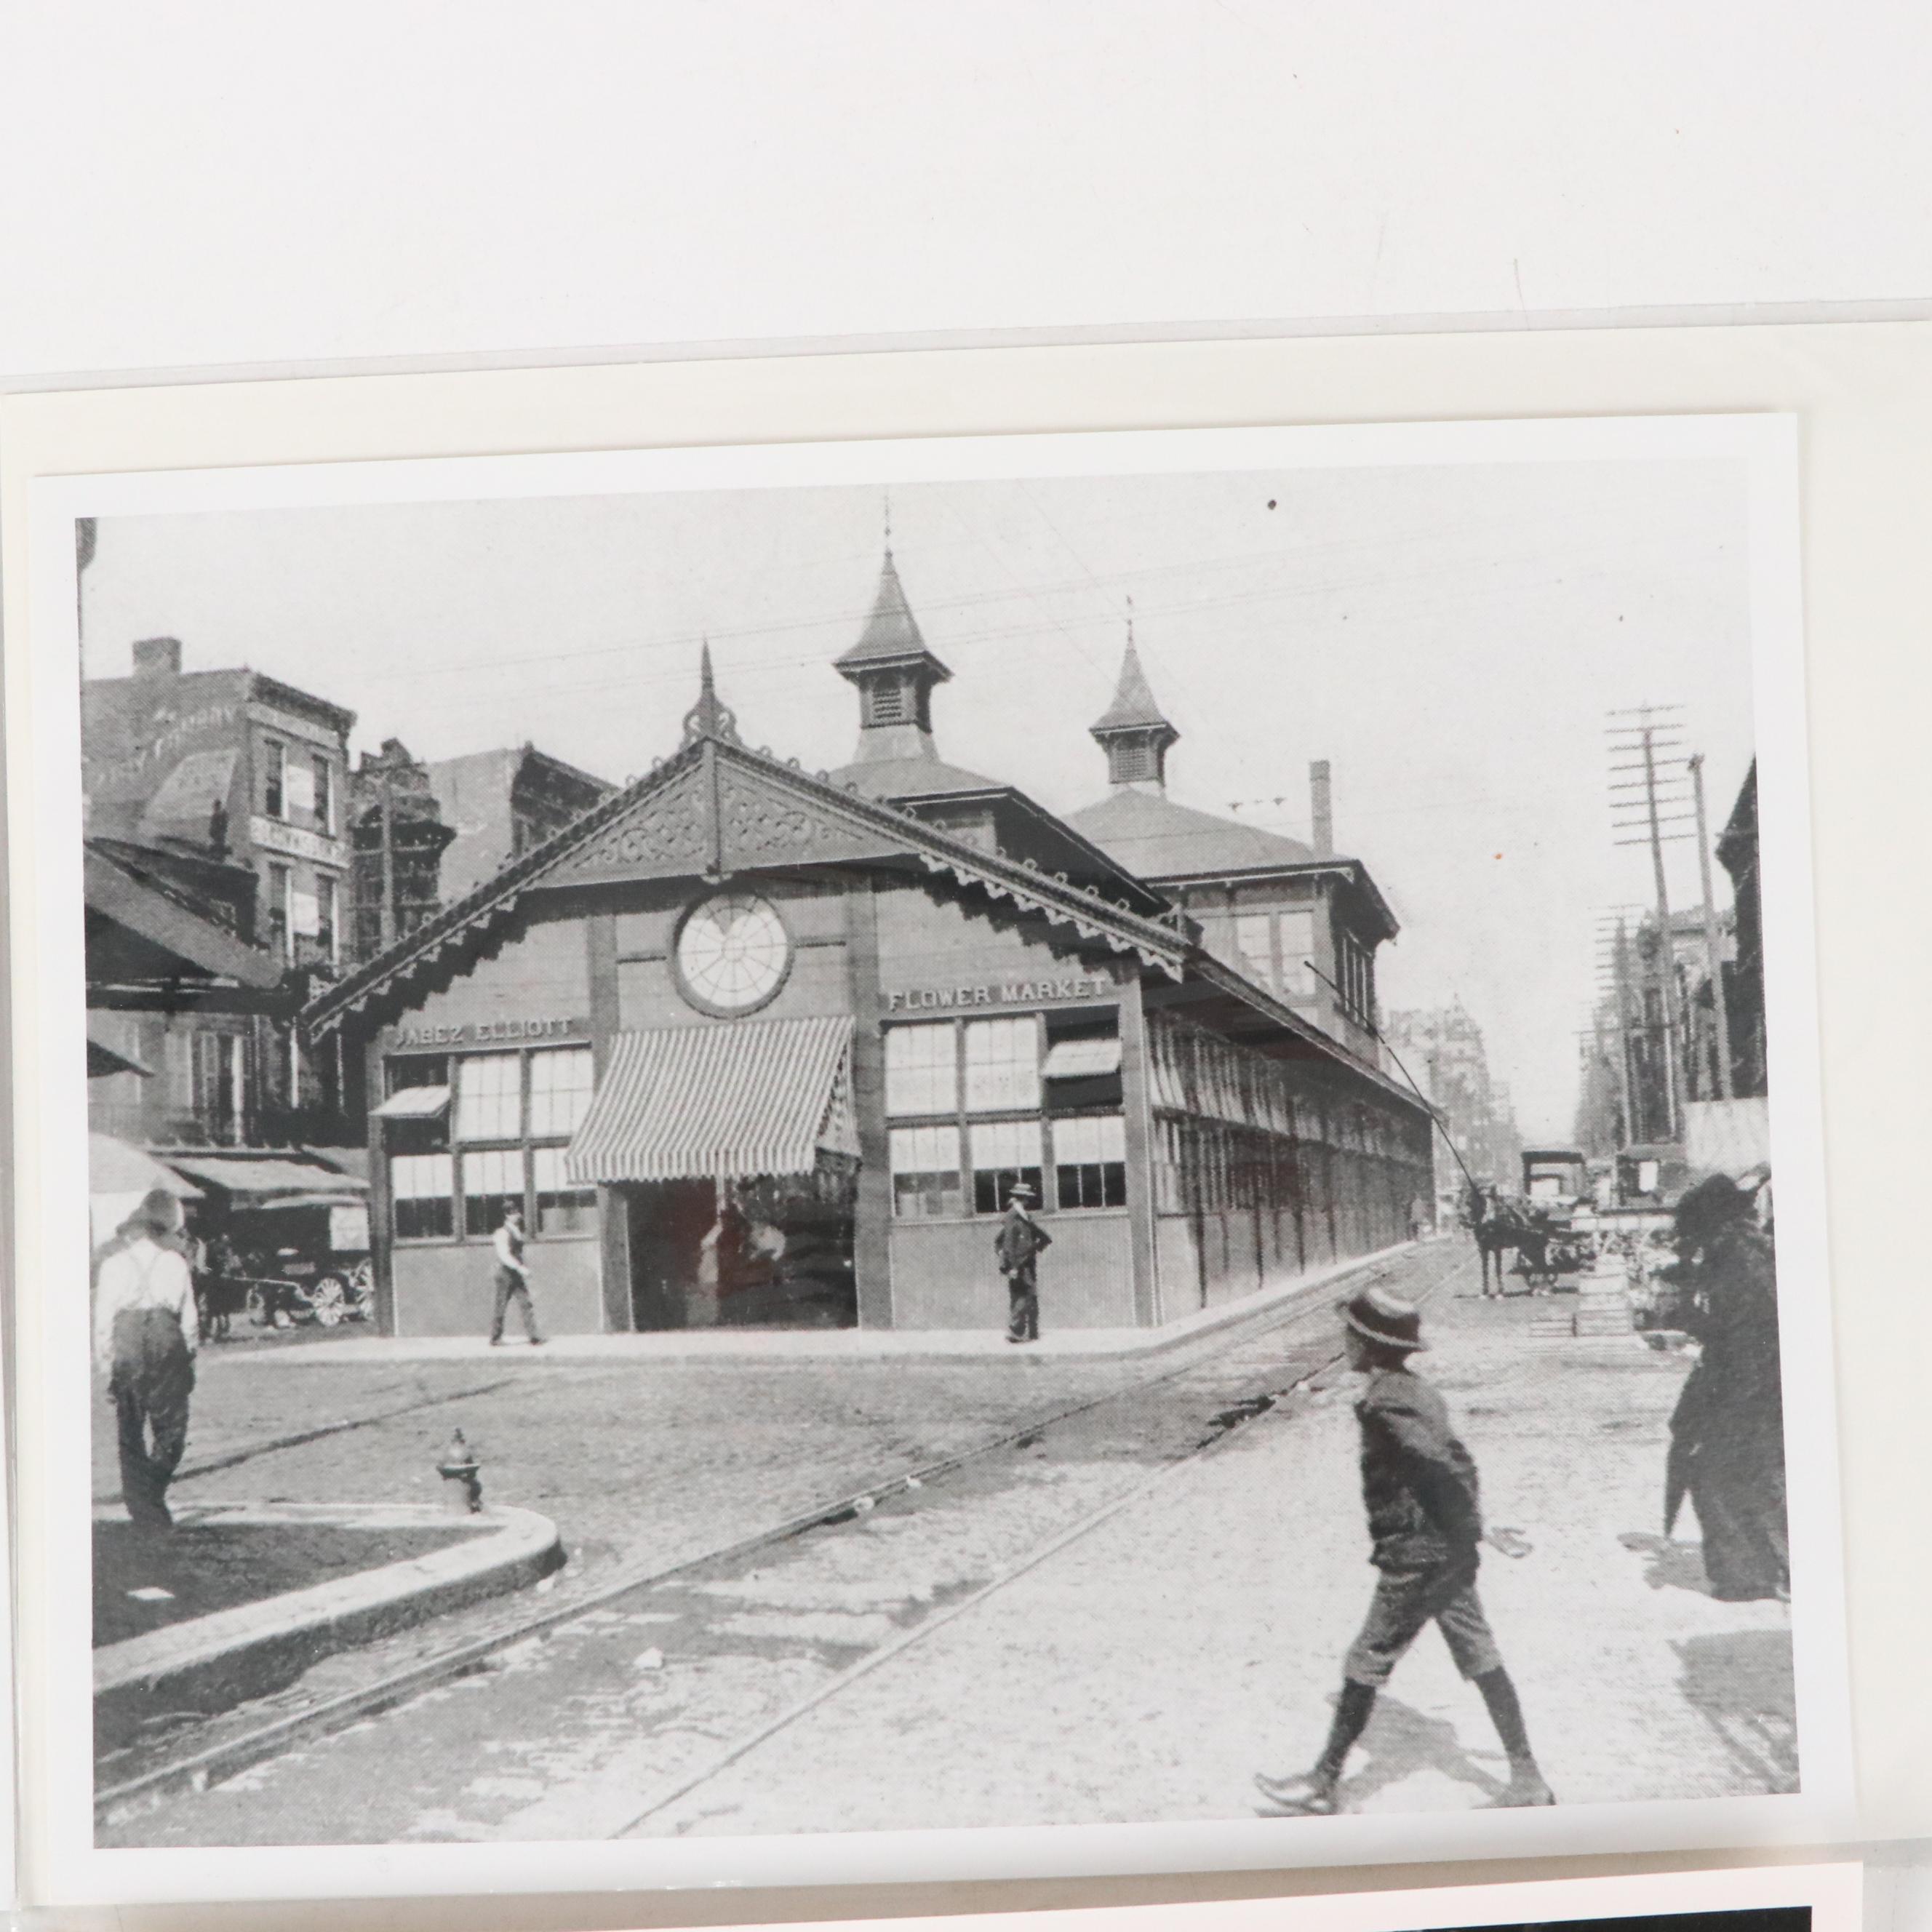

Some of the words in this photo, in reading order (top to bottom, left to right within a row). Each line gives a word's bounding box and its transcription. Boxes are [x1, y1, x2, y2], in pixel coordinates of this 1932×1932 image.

[888, 986, 990, 1010] FLOWER
[1002, 978, 1105, 1002] MARKET
[397, 1028, 463, 1047] JABEZ
[477, 1020, 572, 1040] ELLIOTT
